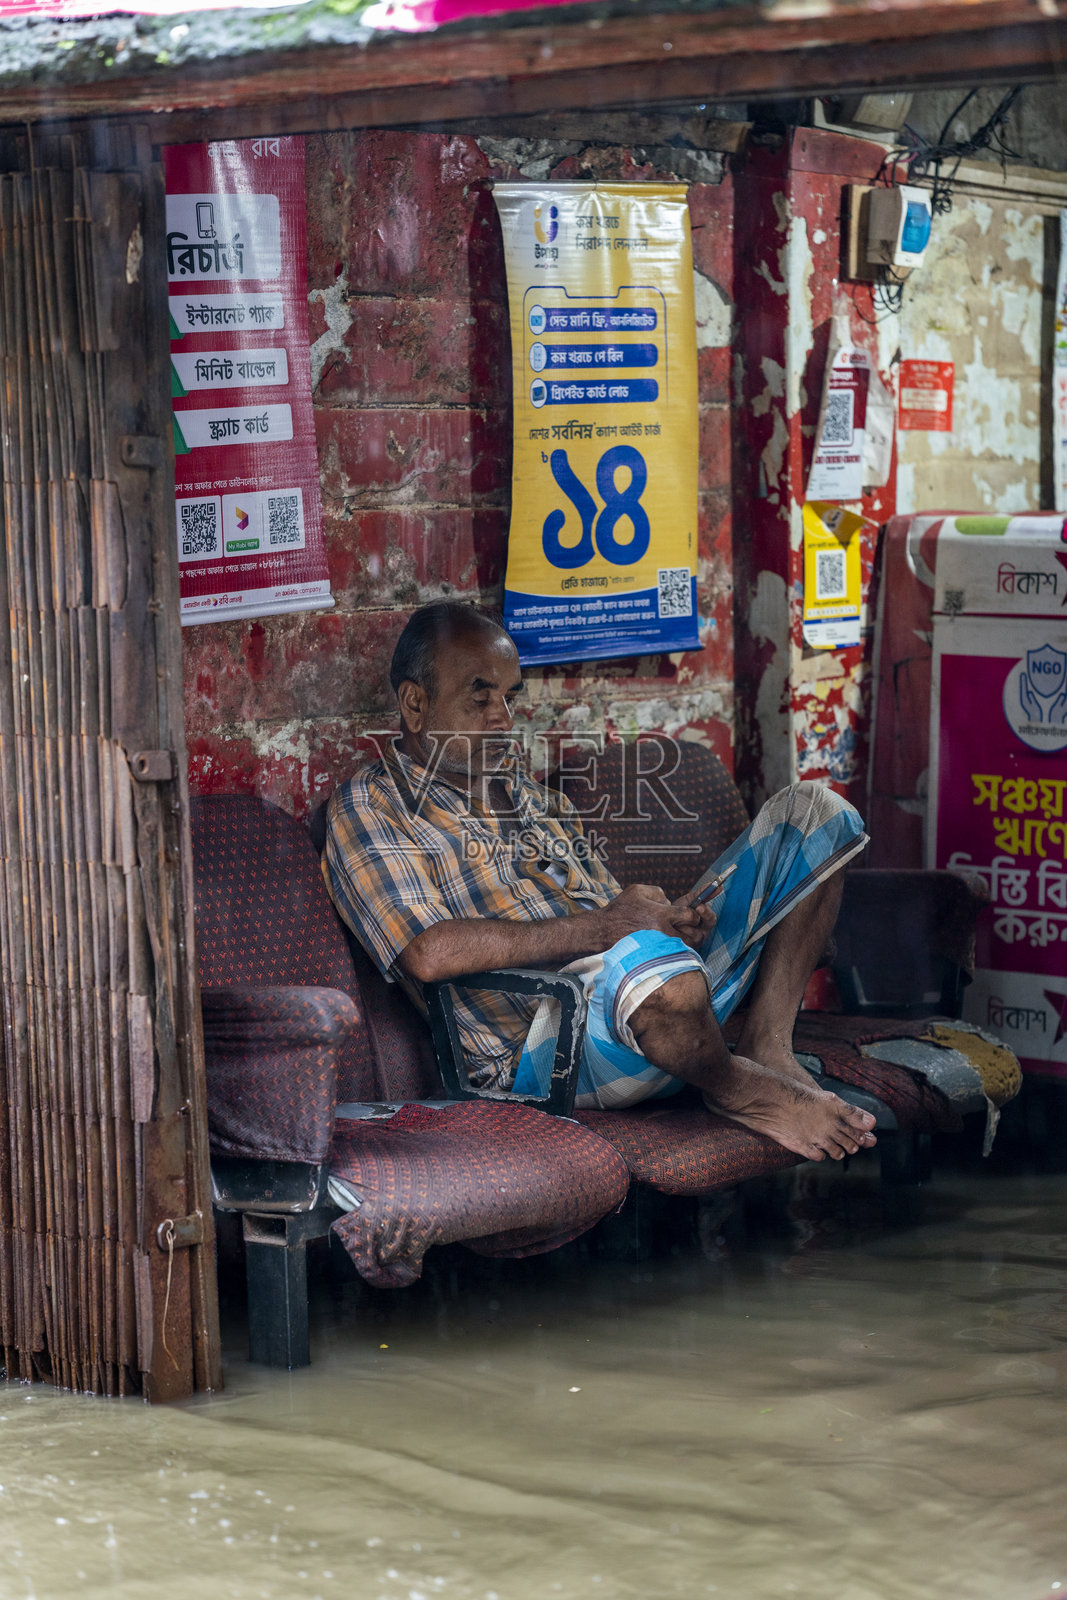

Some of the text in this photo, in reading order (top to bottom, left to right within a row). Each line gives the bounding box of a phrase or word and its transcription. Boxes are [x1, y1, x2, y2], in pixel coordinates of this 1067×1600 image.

[167, 231, 244, 274] রিচার্জ
[186, 304, 275, 326] ইন্টারনেট প্যাক
[550, 315, 568, 327] সেন্ড
[569, 312, 590, 327] মানি
[550, 348, 624, 364] কম খরচে পে বিল
[195, 358, 276, 381] মিনিট বান্ডেল
[551, 384, 629, 401] প্রিপেইড কার্ড লোড
[208, 412, 269, 441] স্ক্র্যাচ কার্ড
[529, 428, 549, 440] দেশের
[595, 426, 618, 437] ক্যাশ
[619, 423, 643, 436] আউট
[644, 421, 662, 436] চার্জ
[542, 445, 650, 569] ১৪
[997, 562, 1057, 595] বিকাশ
[1032, 661, 1061, 675] NGO
[987, 995, 1047, 1033] বিকাশ
